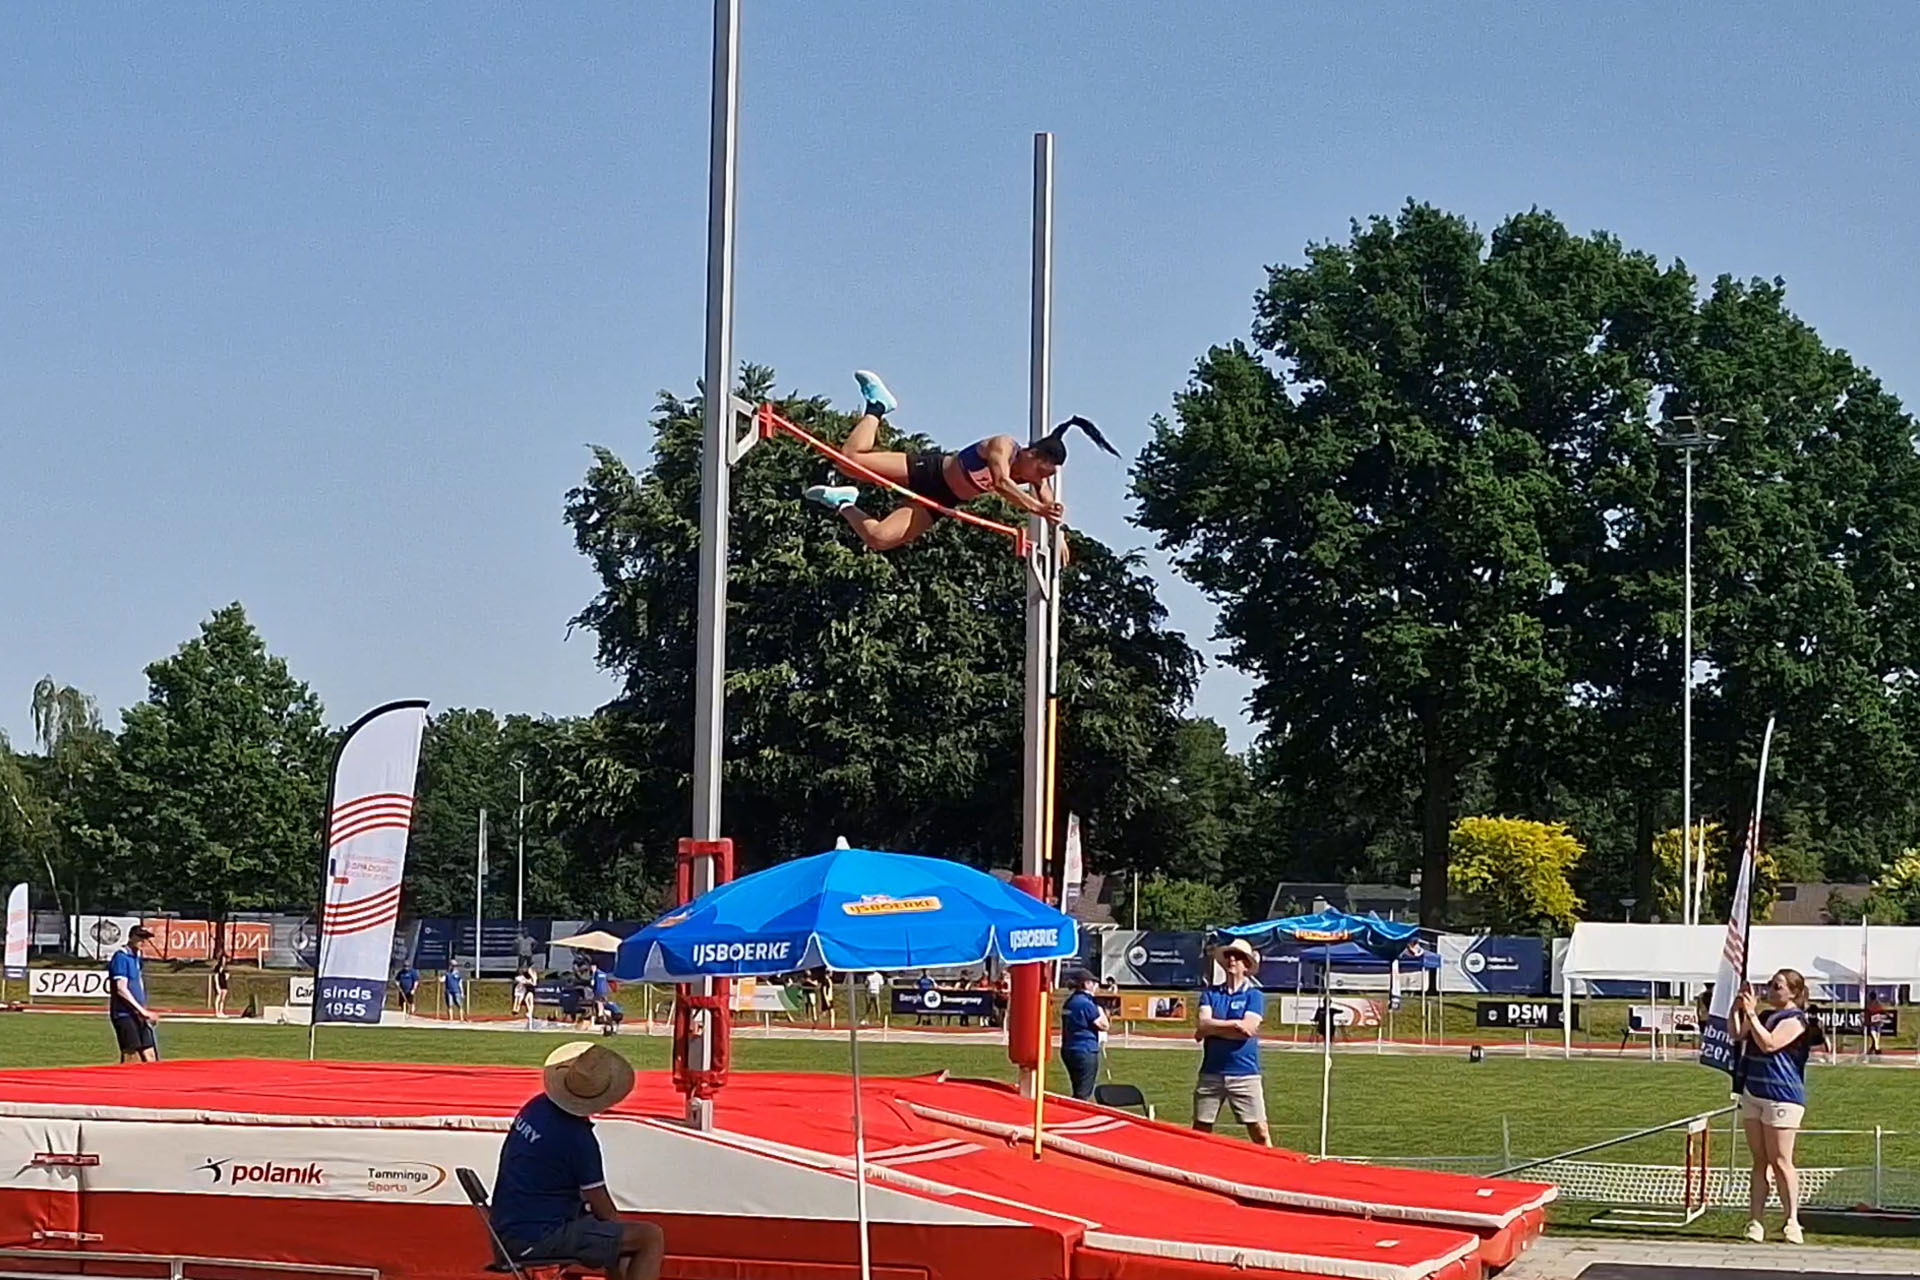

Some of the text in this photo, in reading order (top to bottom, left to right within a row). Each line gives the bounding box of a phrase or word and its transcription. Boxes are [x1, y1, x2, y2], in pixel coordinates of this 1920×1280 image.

[1009, 927, 1059, 953] IJSBOERKE
[692, 942, 791, 967] IJSBOERKE
[323, 985, 372, 1001] sinds
[325, 1002, 367, 1018] 1955
[1507, 1004, 1549, 1020] DSM
[515, 1116, 541, 1143] URY
[231, 1161, 324, 1185] polanik
[368, 1167, 428, 1183] Tamminga
